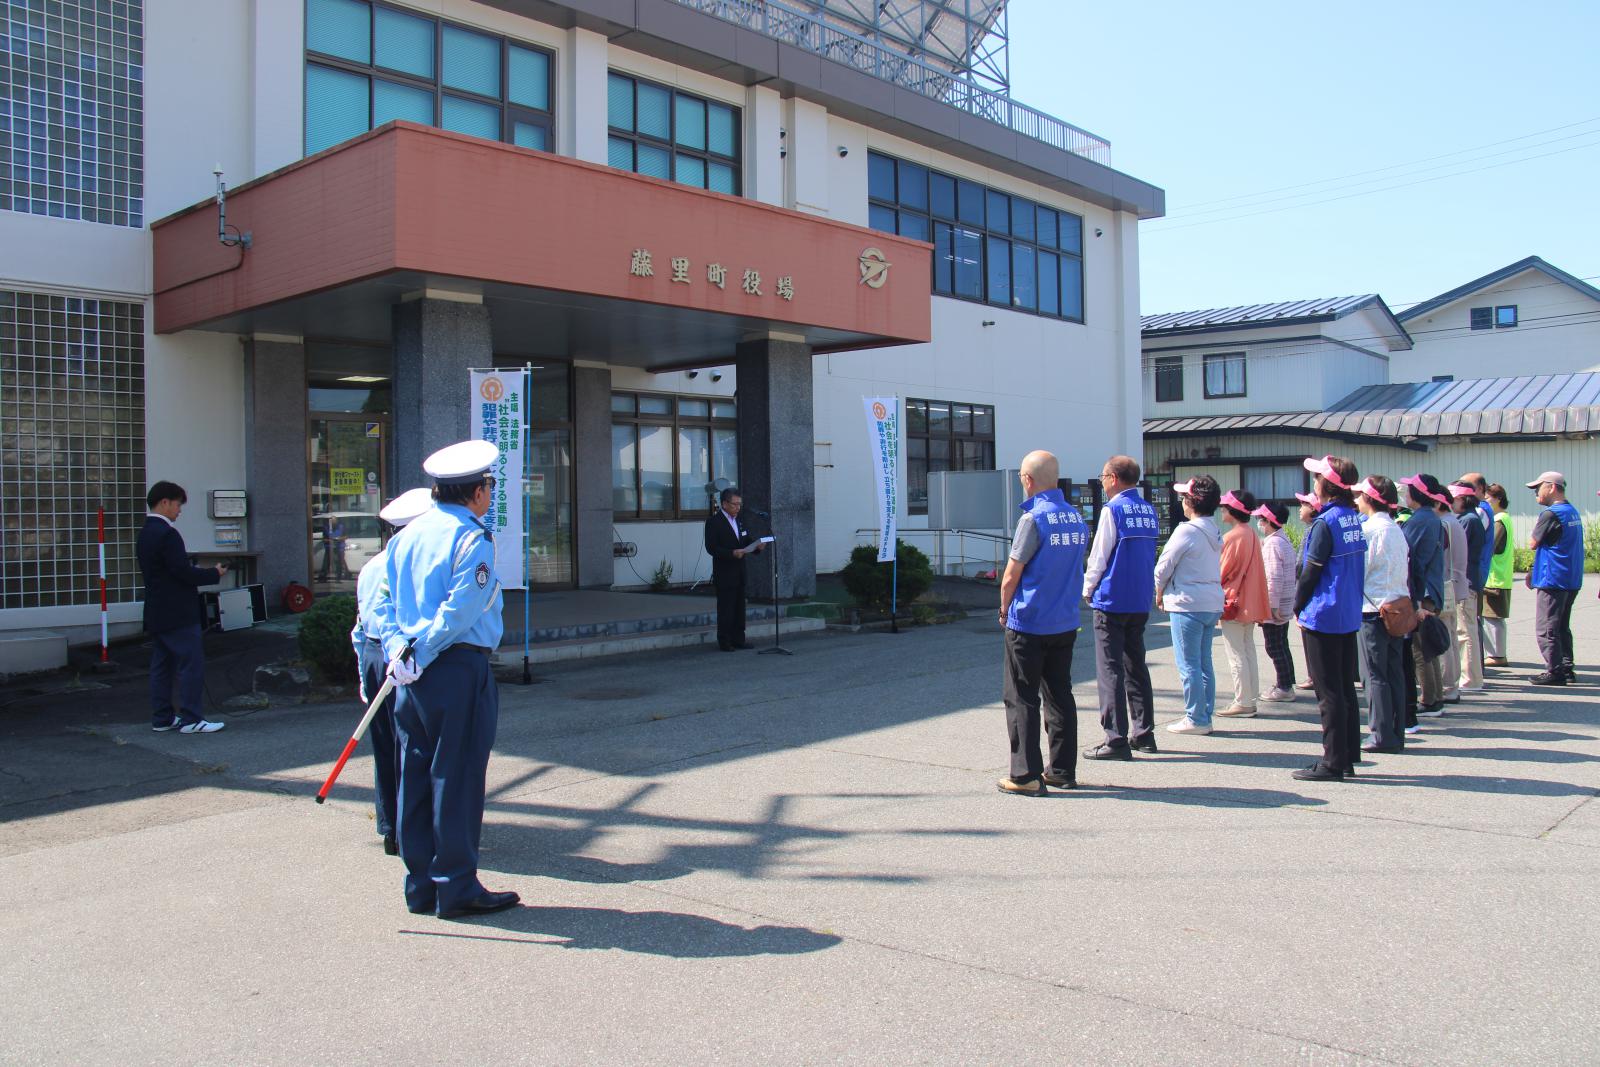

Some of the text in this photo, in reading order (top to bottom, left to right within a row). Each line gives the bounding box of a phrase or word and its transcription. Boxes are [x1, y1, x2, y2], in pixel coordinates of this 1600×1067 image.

[631, 249, 795, 301] 藤里町役場
